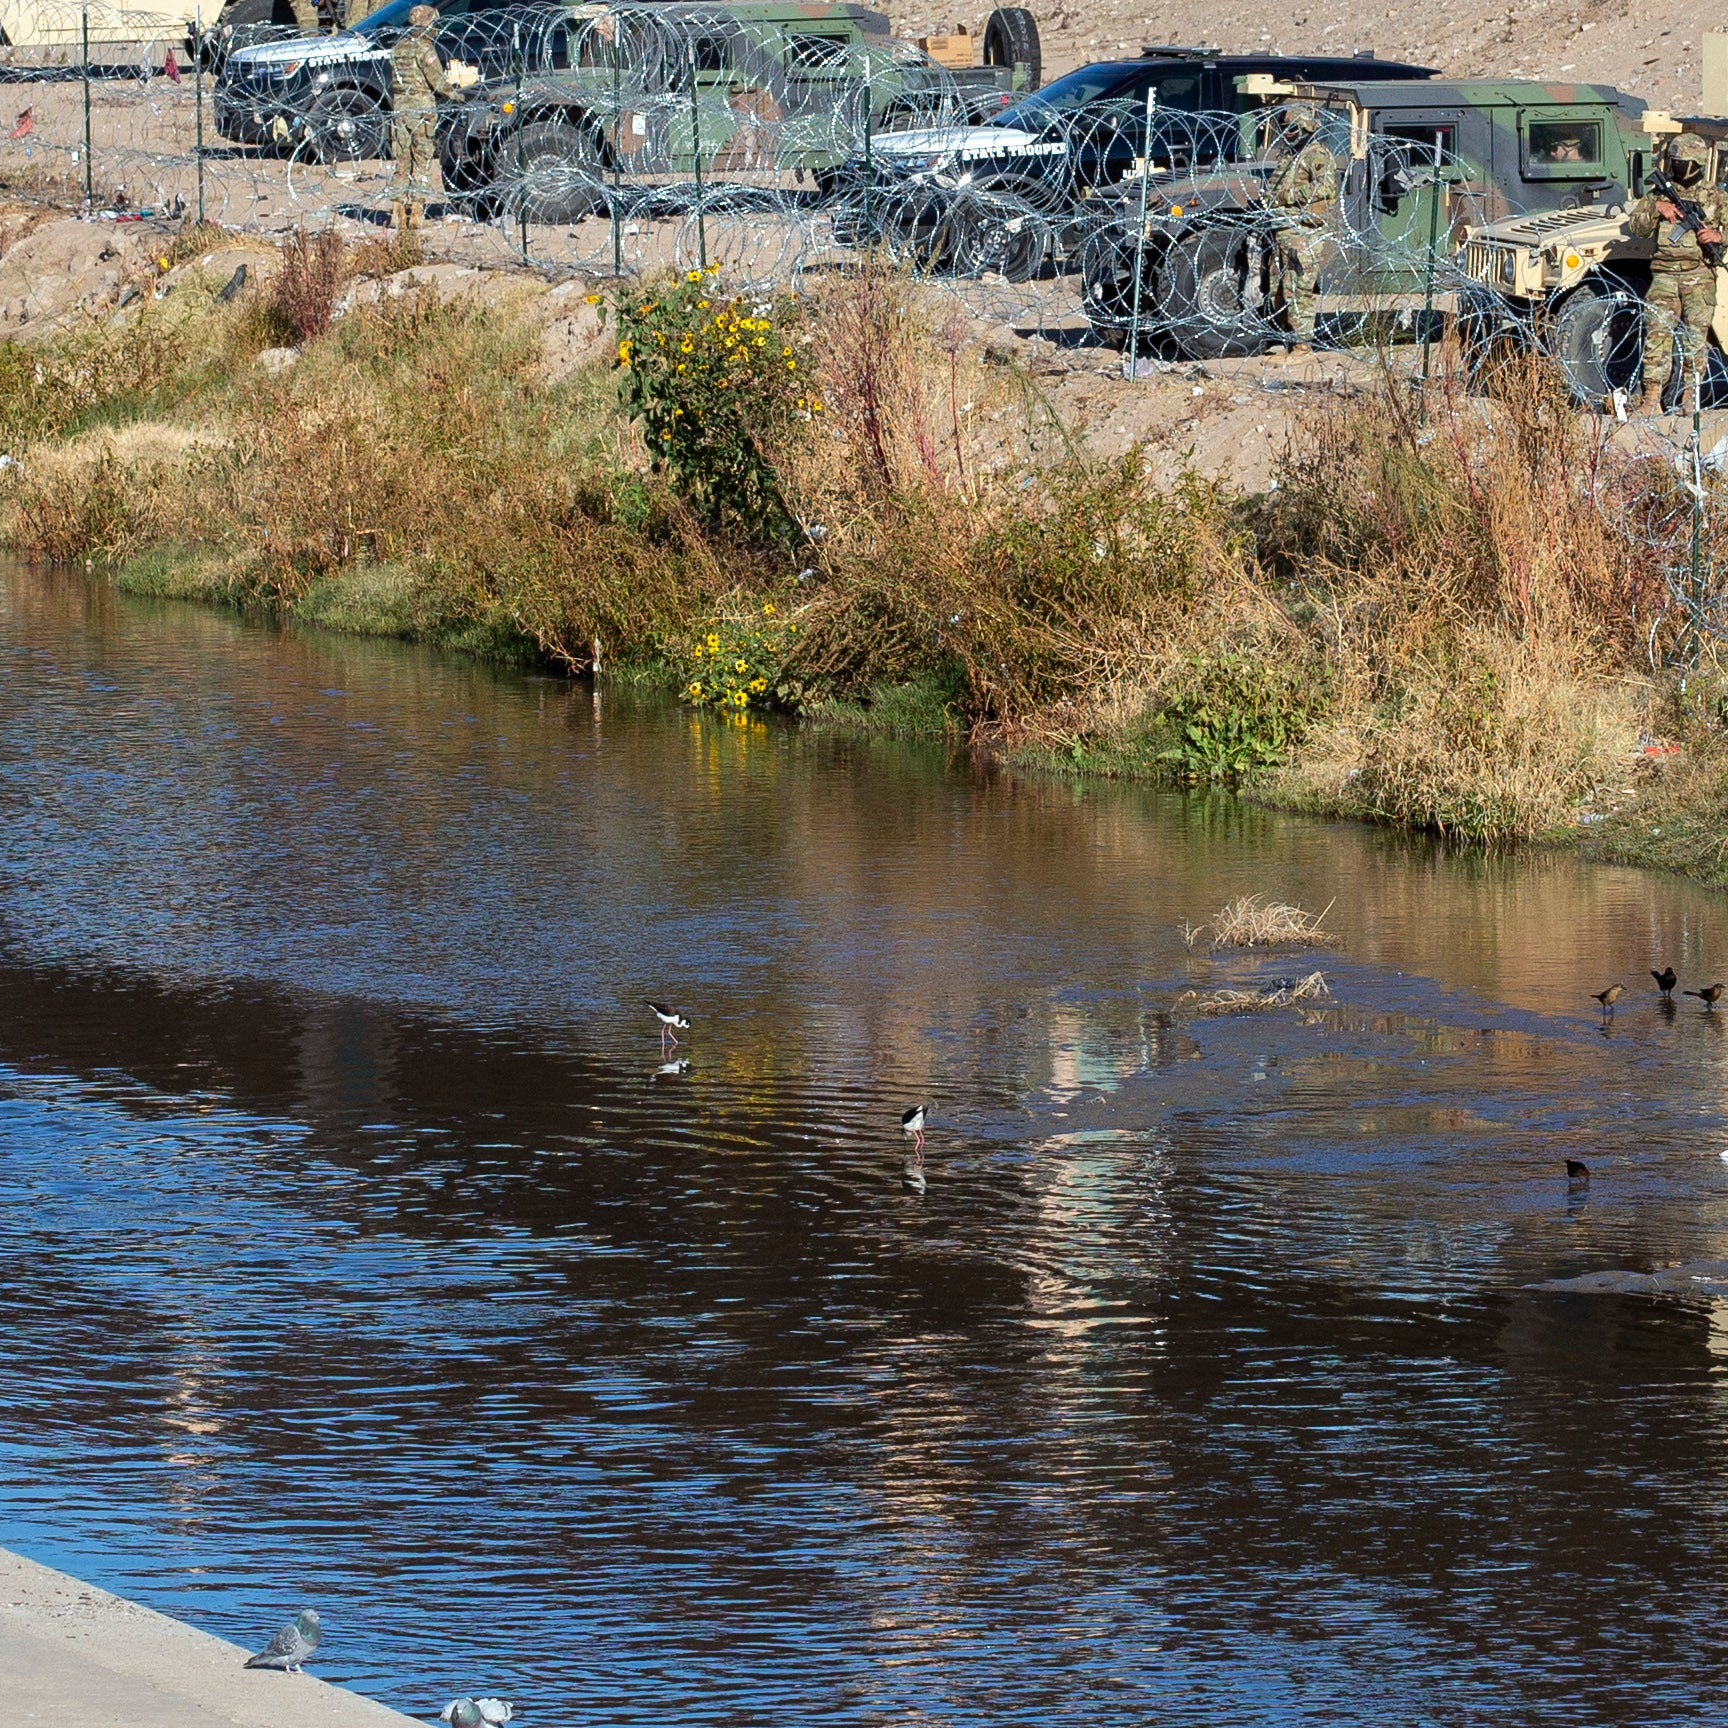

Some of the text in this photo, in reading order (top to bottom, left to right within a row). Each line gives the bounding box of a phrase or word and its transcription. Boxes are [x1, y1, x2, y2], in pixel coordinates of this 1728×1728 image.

[308, 52, 347, 67] STATE
[962, 142, 1067, 161] STATE TROOPER
